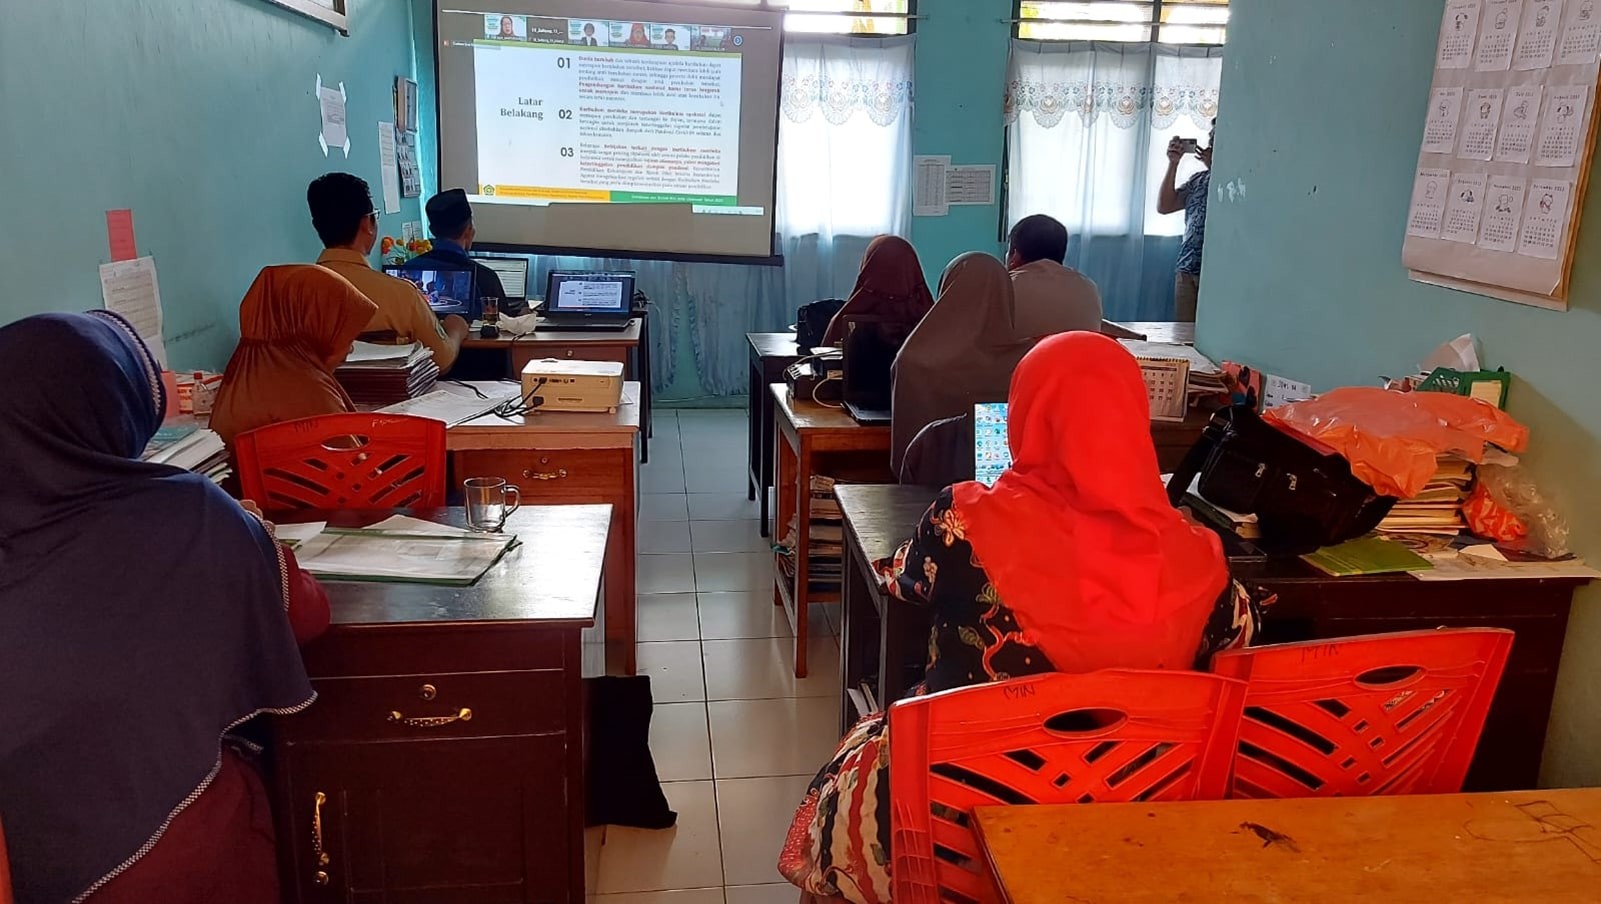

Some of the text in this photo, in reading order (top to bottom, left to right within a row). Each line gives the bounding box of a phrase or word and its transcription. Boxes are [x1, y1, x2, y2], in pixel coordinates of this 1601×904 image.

[557, 57, 571, 69] 01
[518, 96, 544, 106] Latar
[500, 108, 544, 121] Belakang
[558, 109, 572, 120] 02
[560, 147, 574, 157] 03
[1004, 684, 1035, 700] MIN
